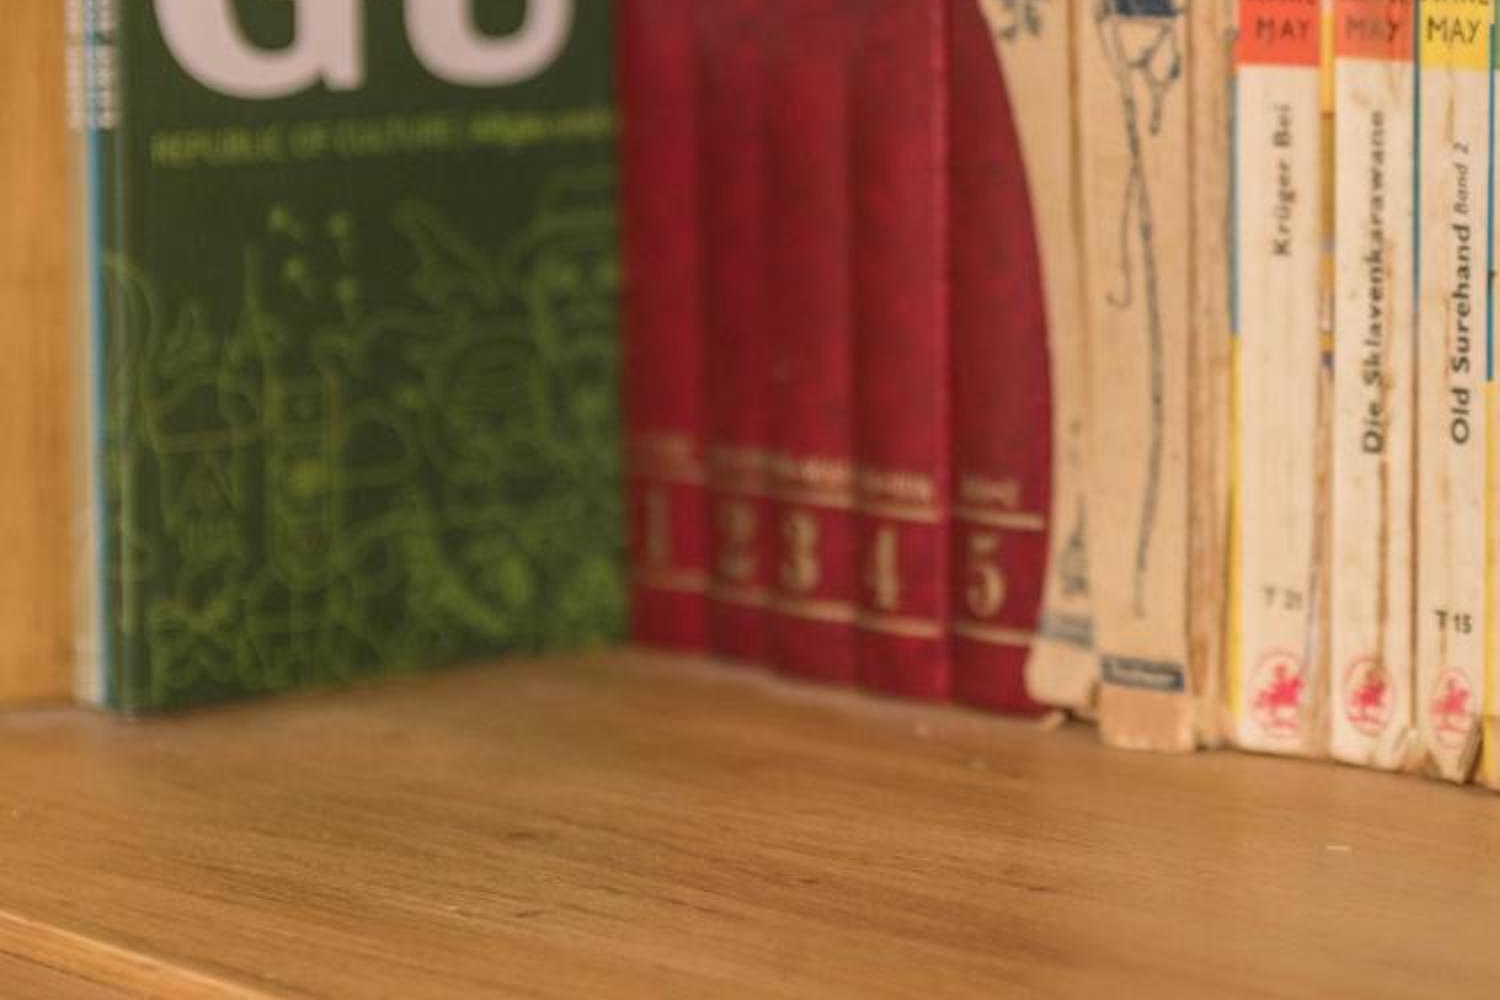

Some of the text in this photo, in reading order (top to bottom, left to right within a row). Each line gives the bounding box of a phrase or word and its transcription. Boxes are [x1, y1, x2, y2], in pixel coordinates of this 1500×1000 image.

[1256, 16, 1311, 43] MAY
[1345, 16, 1400, 43] MAY
[1427, 17, 1481, 48] MAY
[1272, 104, 1296, 257] Krüger Bei
[1362, 110, 1385, 455] Die Sklavenkarawane
[1450, 142, 1471, 445] Old Surehand Band 2
[964, 532, 1006, 619] 5
[1262, 586, 1277, 608] T
[1434, 610, 1473, 635] T 15
